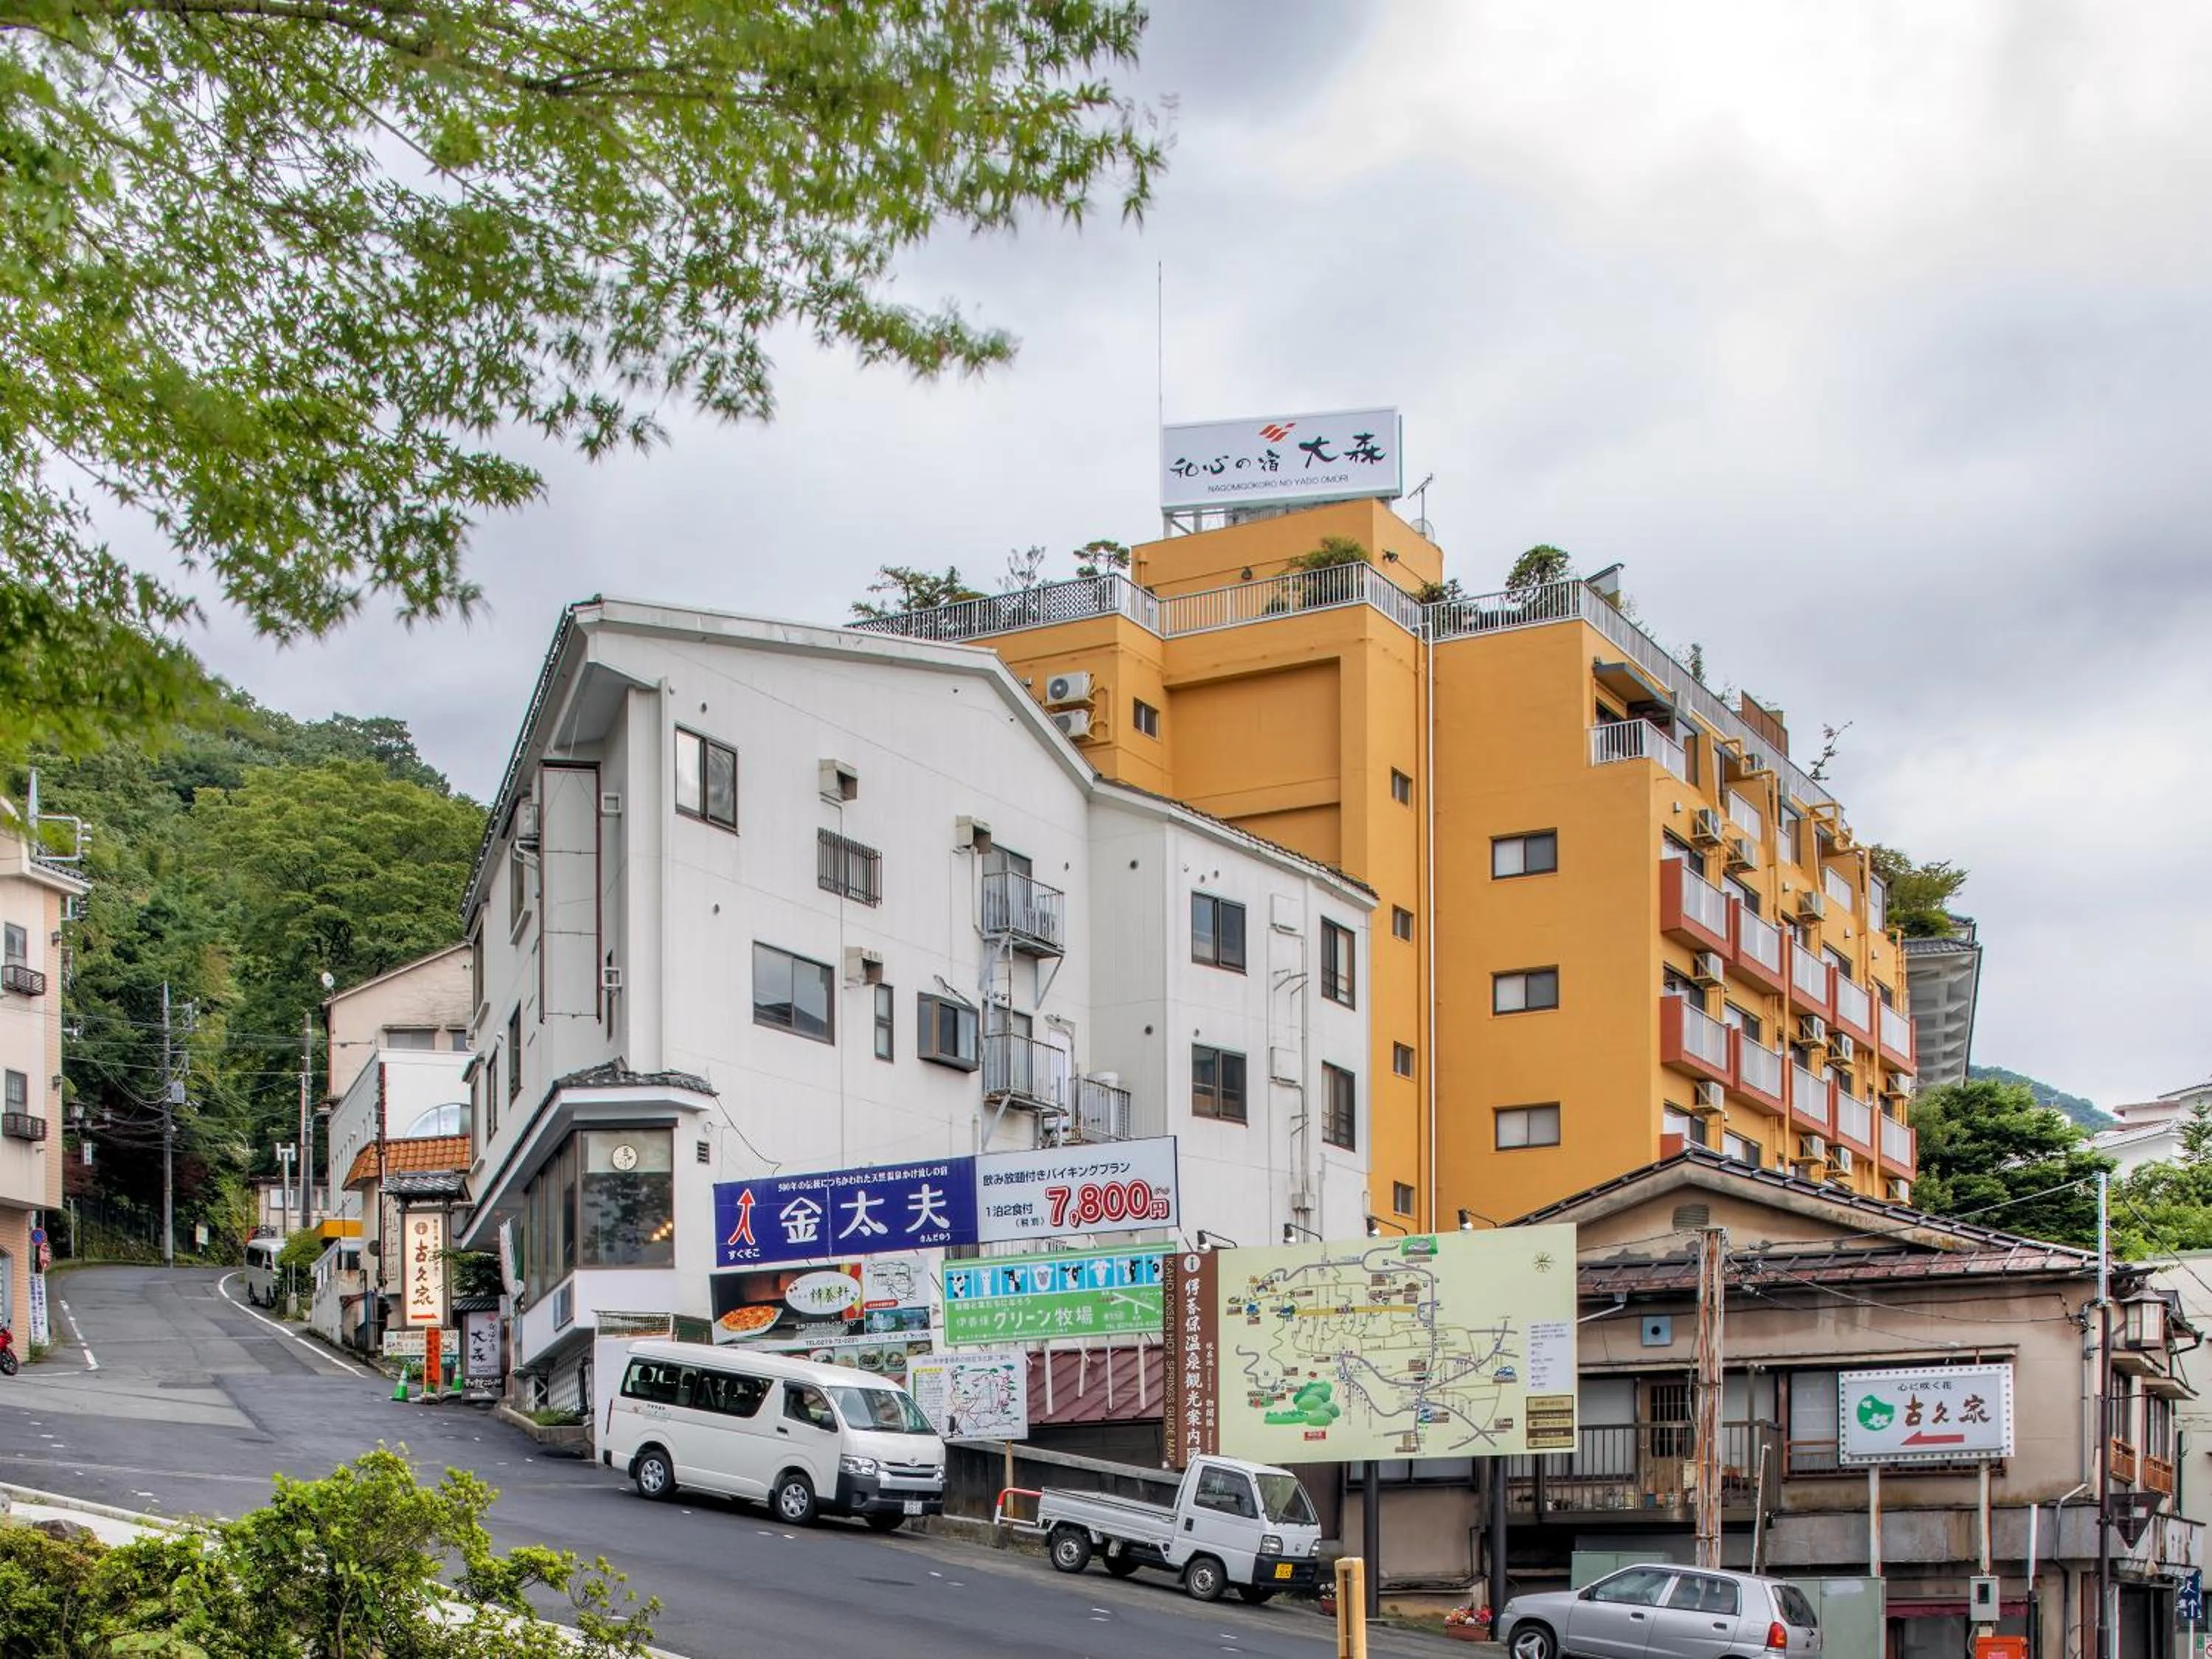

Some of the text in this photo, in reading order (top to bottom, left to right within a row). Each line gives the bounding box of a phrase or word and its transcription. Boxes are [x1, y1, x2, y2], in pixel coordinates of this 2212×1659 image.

[1298, 432, 1387, 469] 大森
[1279, 479, 1293, 487] NO
[1295, 477, 1319, 486] YADO
[983, 1162, 1130, 1186] 飲み放題付きバイキングプラン
[779, 1183, 951, 1244] 金太夫
[985, 1202, 1033, 1218] 1泊2食付
[728, 1248, 761, 1261] すぐそこ
[413, 1238, 434, 1306] 古久家
[993, 1305, 1094, 1331] グリーン牧場
[470, 1329, 487, 1363] 大森
[1165, 1256, 1176, 1461] IKAHO ONSEN HOT SPRINGS GUIDE MAP
[1897, 1380, 1955, 1392] 心に咲く花
[1904, 1391, 1992, 1427] 古久家
